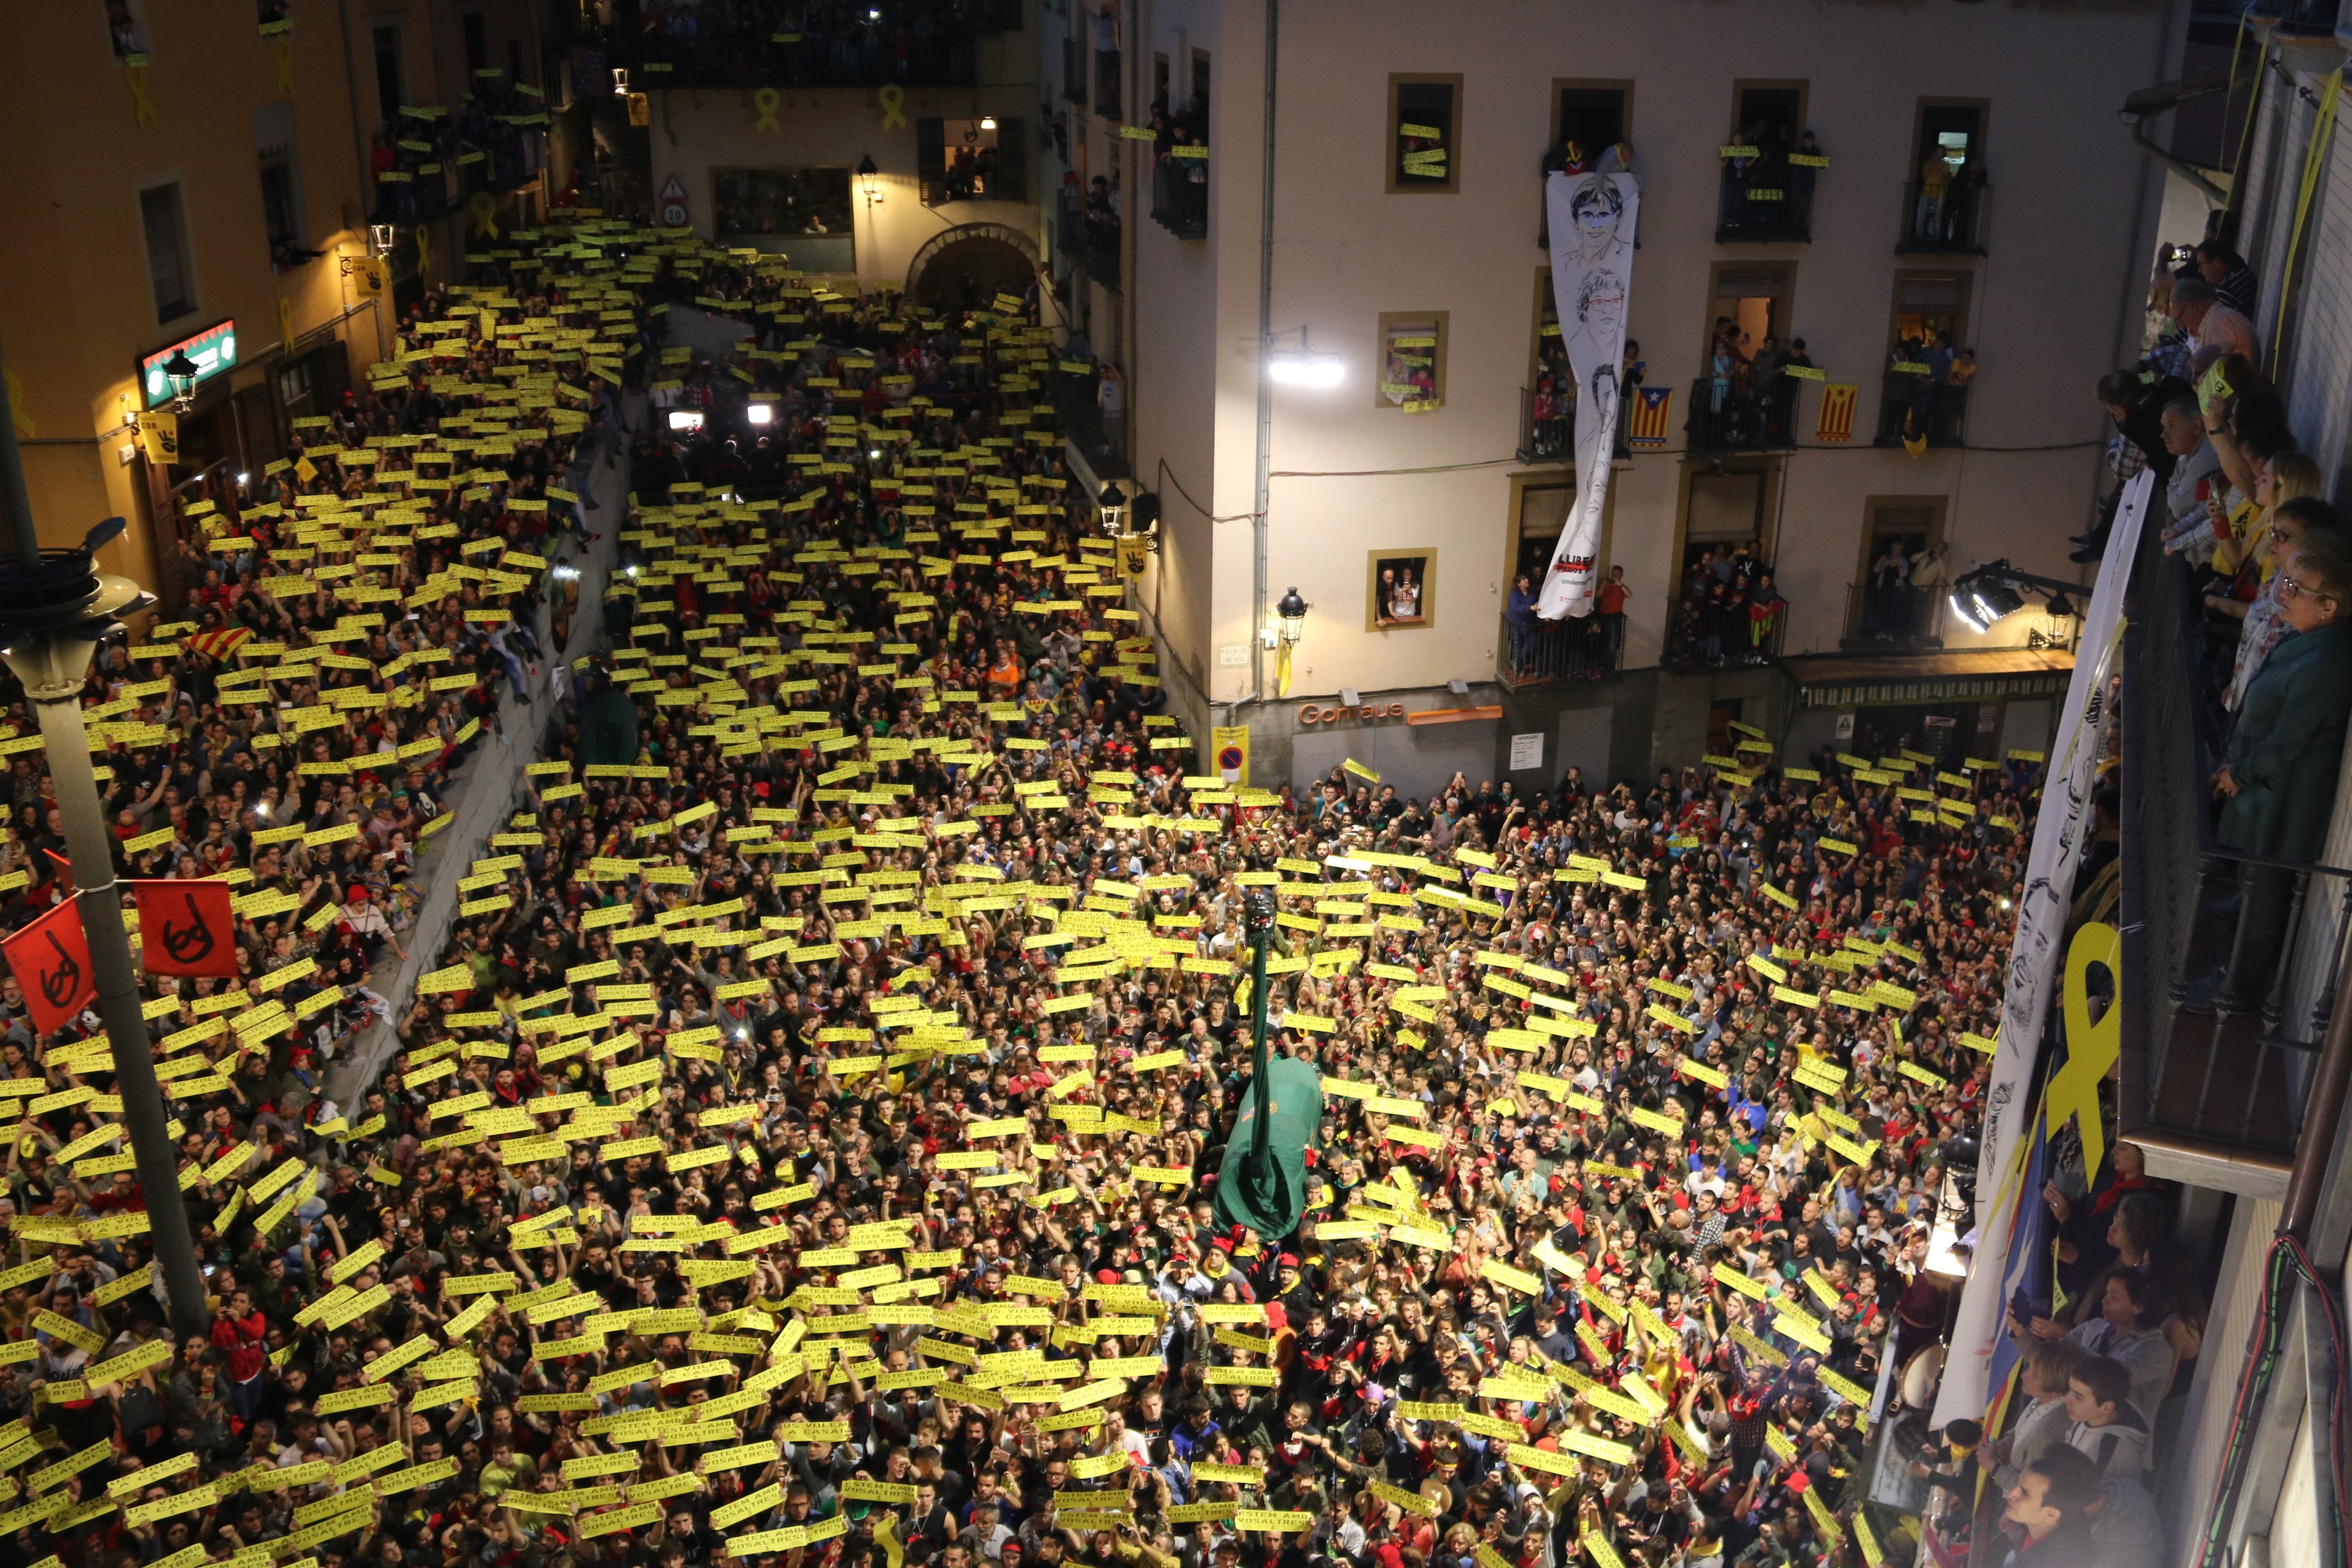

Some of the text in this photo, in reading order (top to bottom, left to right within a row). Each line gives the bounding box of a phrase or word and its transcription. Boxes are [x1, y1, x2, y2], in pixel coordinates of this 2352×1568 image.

[669, 210, 681, 220] 20
[413, 736, 439, 746] VOLEM
[477, 895, 507, 904] VOLEM
[259, 958, 311, 982] US VOLEM
[277, 964, 309, 980] CASA!
[568, 965, 595, 973] ESTEM
[1500, 978, 1529, 991] VOLEM
[164, 1017, 221, 1042] ESTEM AMB
[602, 1140, 634, 1150] ESTEM
[602, 1141, 660, 1156] VOSALTRES
[688, 1145, 725, 1157] VOLEM
[688, 1151, 722, 1162] CASA!
[251, 1158, 296, 1193] ESTEM AMB
[755, 1183, 810, 1201] ESTEM AMB
[755, 1188, 813, 1206] VOSALTRES
[447, 1276, 482, 1284] ESTEM
[447, 1279, 511, 1290] VOSALTRES
[445, 1293, 491, 1330] ESTEM AMB
[449, 1298, 493, 1335] VOSALTRES
[41, 1310, 103, 1343] ESTEM AMB
[88, 1338, 165, 1375] ESTEM AMB
[366, 1334, 426, 1371] ESTEM AMB
[368, 1340, 428, 1376] VOSALTRES
[90, 1345, 166, 1381] VOSALTRES
[683, 1365, 723, 1376] CASA!
[684, 1359, 728, 1371] VOLEM
[318, 1384, 388, 1402] ESTEM AMB
[319, 1391, 389, 1408] VOSALTRES
[563, 1451, 634, 1467] ESTEM AMB
[704, 1441, 774, 1460] ESTEM AMB
[1510, 1443, 1575, 1465] ESTEM AMB
[31, 1441, 108, 1482] ESTEM AMB
[110, 1452, 190, 1486] US VOLEM
[138, 1459, 186, 1481] CASA!
[378, 1457, 451, 1484] ESTEM AMB
[1217, 1463, 1261, 1472] VOLEM
[380, 1463, 453, 1490] VOSALTRES
[1215, 1469, 1255, 1478] CASA!
[128, 1485, 212, 1515] US VOLEM
[156, 1493, 208, 1513] CASA!
[713, 1485, 778, 1517] ESTEM AMB
[715, 1490, 781, 1523] VOSALTRES
